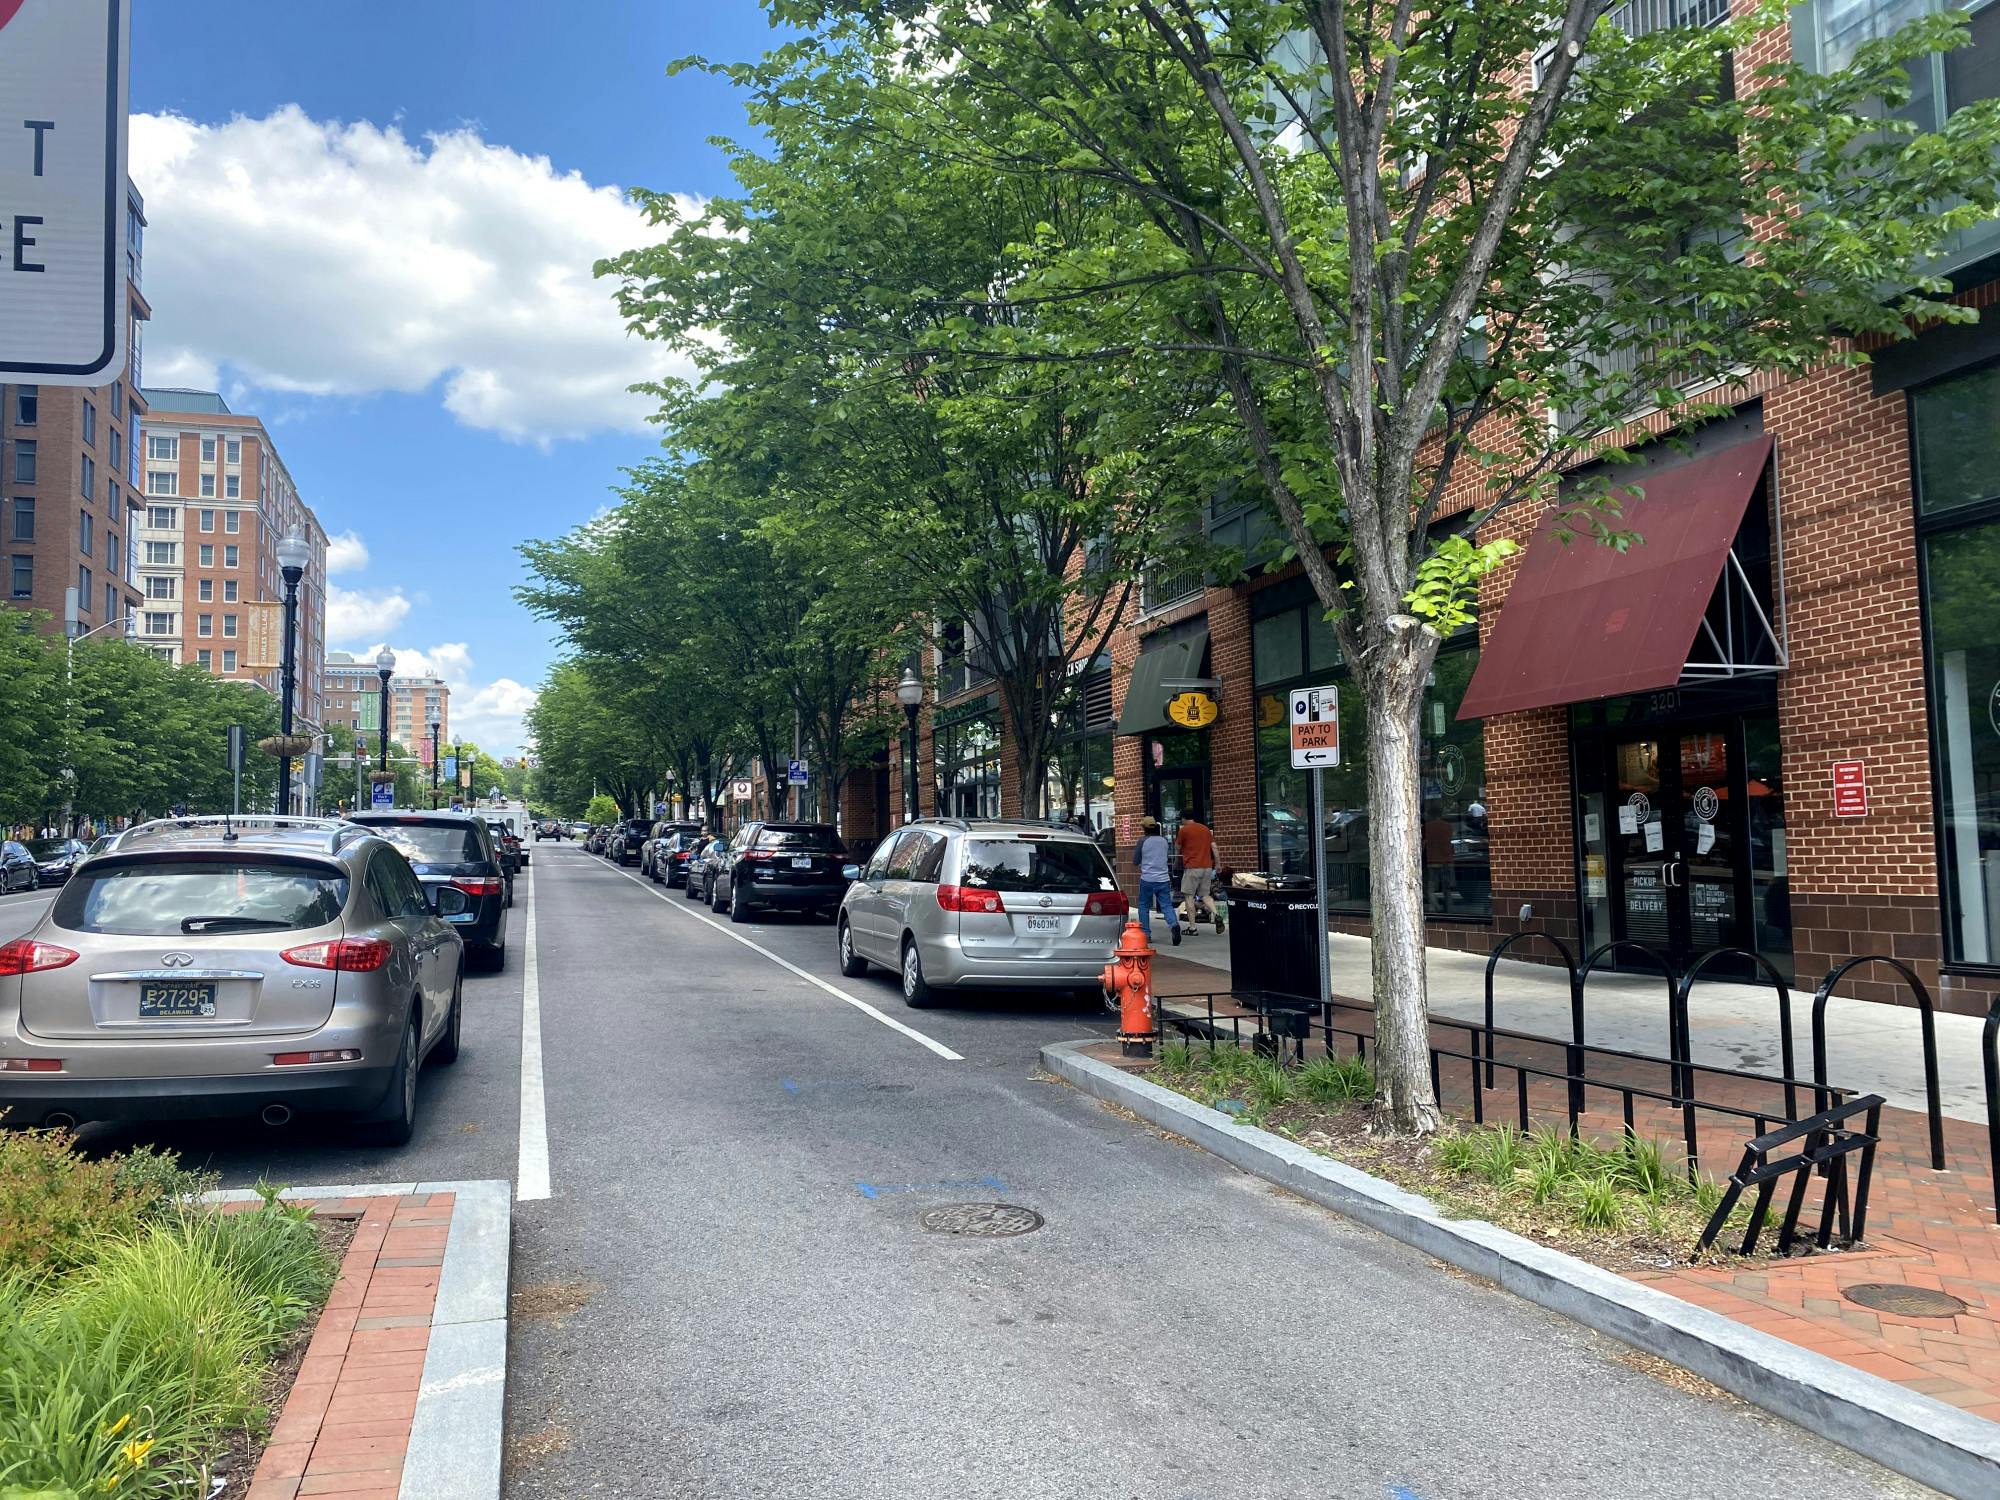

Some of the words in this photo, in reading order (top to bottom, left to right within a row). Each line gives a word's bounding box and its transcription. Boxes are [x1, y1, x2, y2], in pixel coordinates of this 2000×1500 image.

[1650, 689, 1681, 711] 3201
[1298, 725, 1316, 736] PAY
[1318, 724, 1331, 734] TO
[1302, 735, 1328, 747] PARK
[1633, 877, 1657, 887] PICKUP
[1630, 900, 1663, 911] DELIVERY
